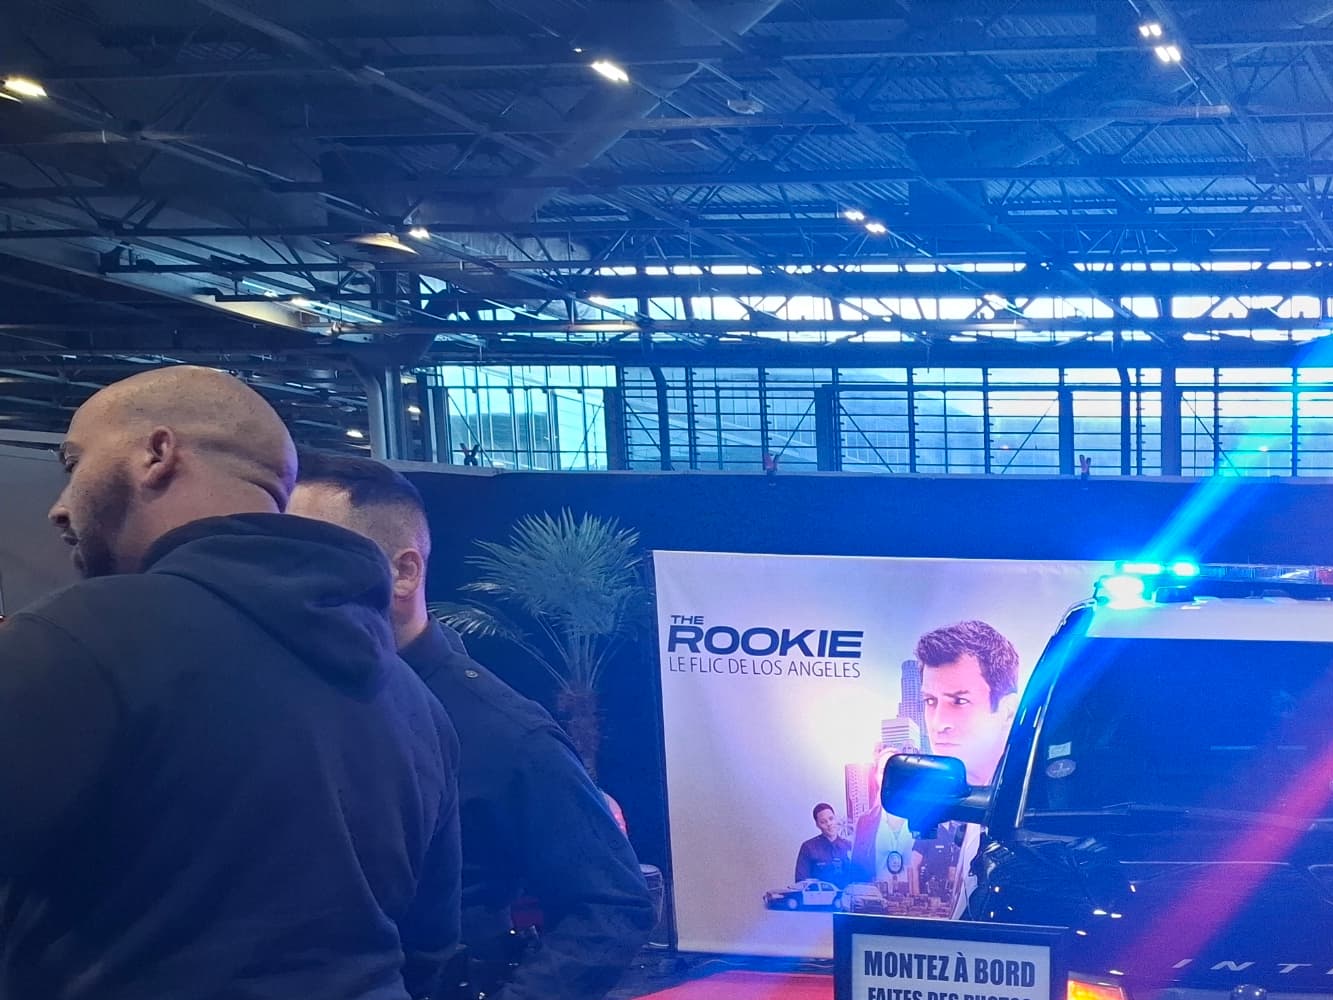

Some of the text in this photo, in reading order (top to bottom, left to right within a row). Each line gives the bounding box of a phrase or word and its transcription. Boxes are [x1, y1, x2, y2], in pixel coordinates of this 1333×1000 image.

[671, 615, 704, 625] THE
[668, 625, 864, 658] ROOKIE
[669, 656, 861, 678] LE FLIC DE LOS ANGELES
[864, 950, 1035, 987] MONTEZ À BORD
